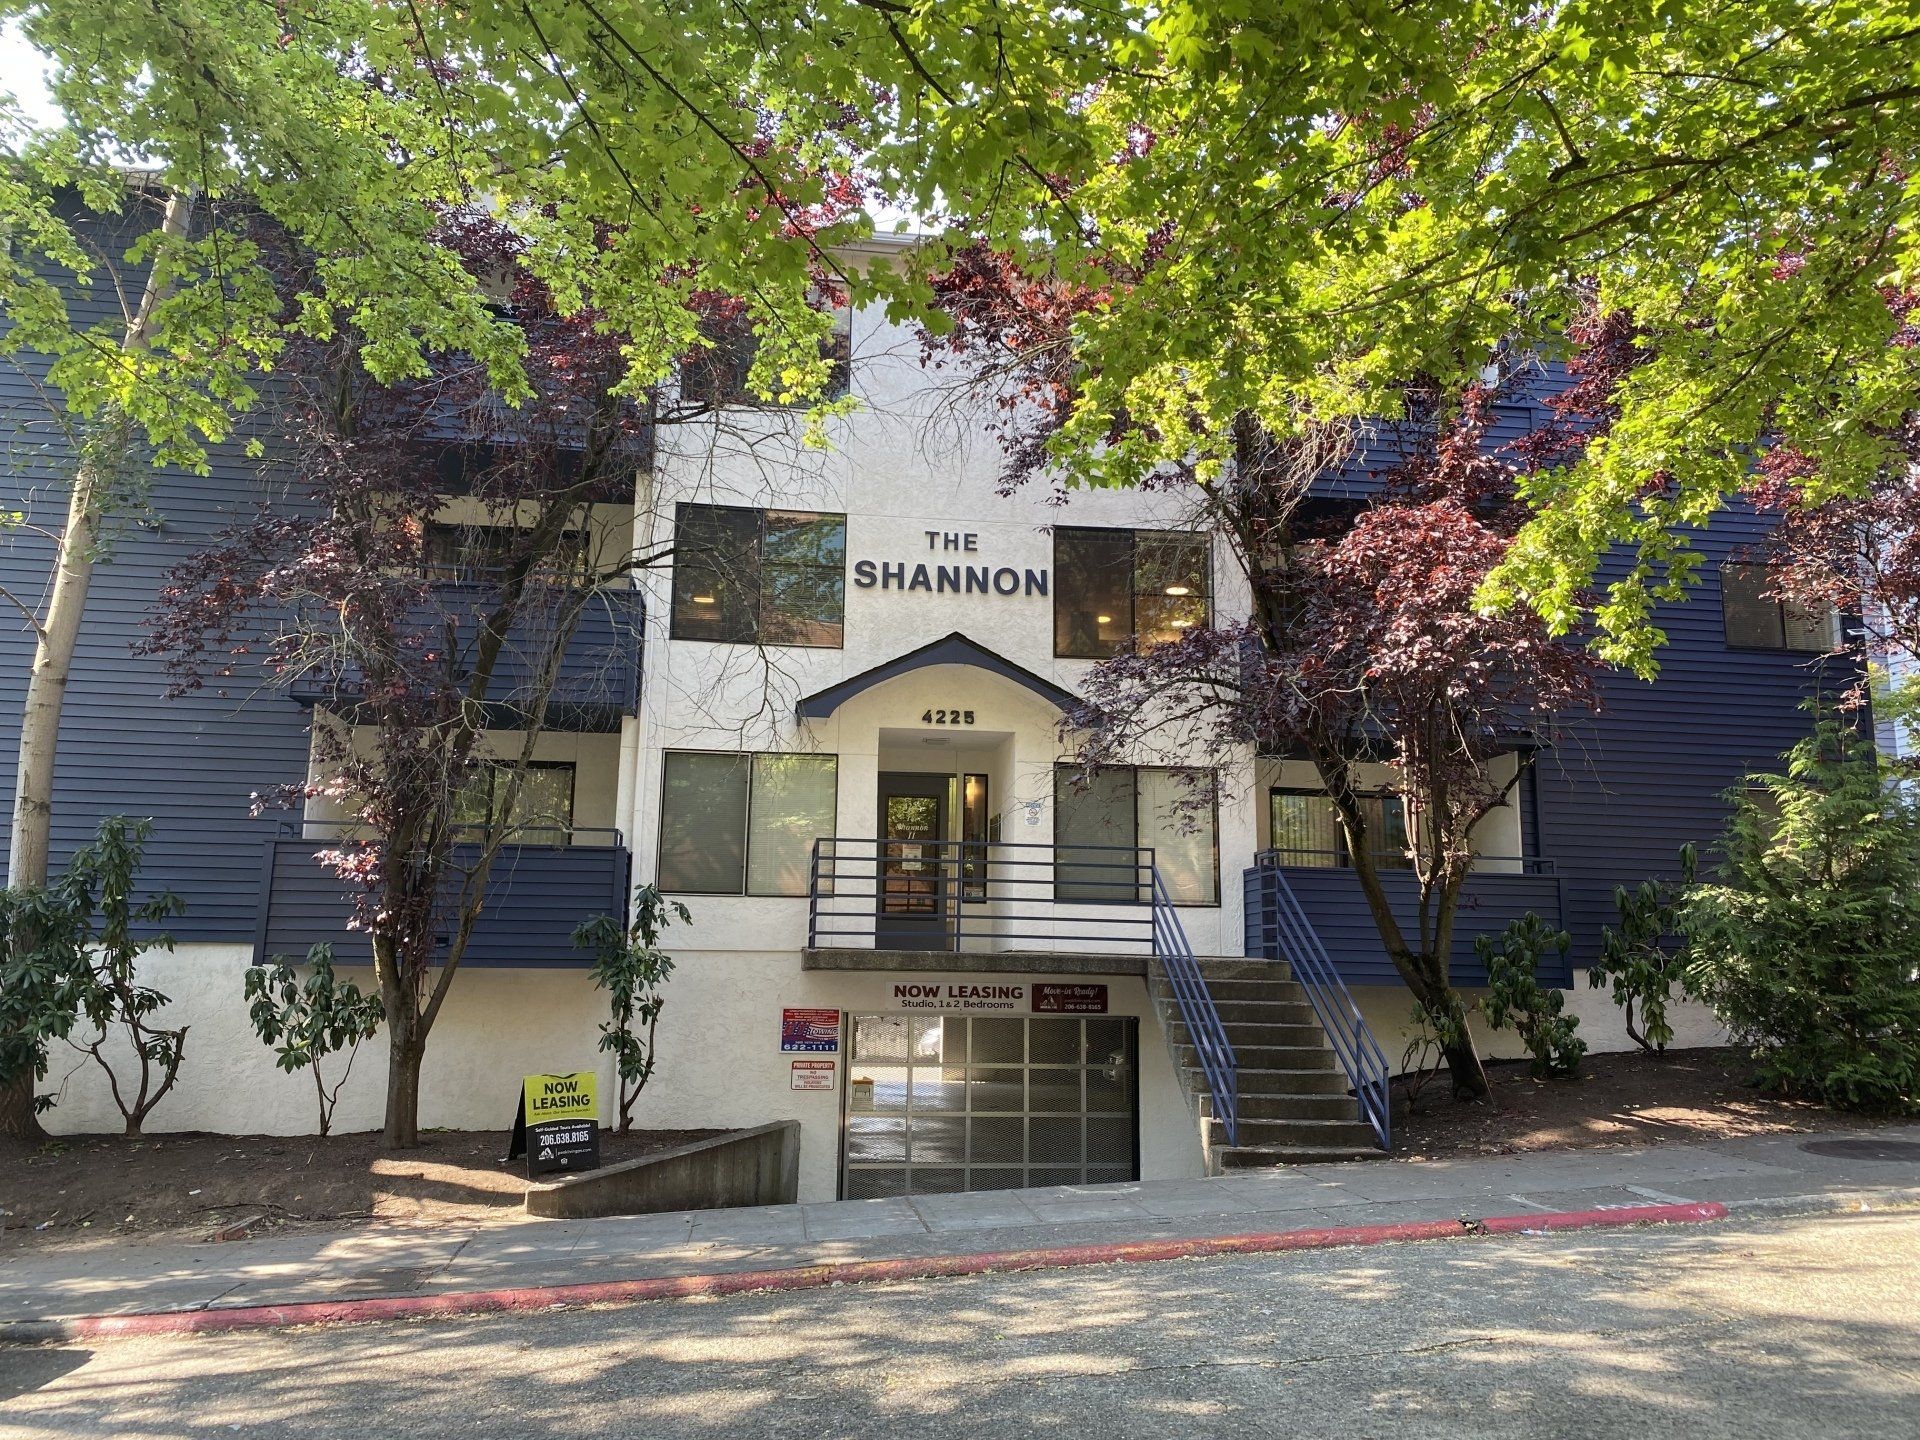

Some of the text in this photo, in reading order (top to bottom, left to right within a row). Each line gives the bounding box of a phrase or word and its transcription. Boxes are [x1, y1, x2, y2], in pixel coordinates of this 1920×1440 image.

[925, 531, 978, 551] THE
[854, 560, 1048, 596] SHANNON
[921, 709, 975, 725] 4225
[894, 985, 1024, 999] NOW LEASING
[1042, 986, 1098, 998] Move-in Ready!
[901, 1000, 937, 1009] Studio,
[939, 1000, 945, 1008] 1
[953, 1000, 960, 1008] 2
[963, 1000, 1015, 1009] Bedrooms
[544, 1081, 578, 1095] NOW
[533, 1094, 591, 1110] LEASING
[540, 1130, 589, 1146] 206.638.8165
